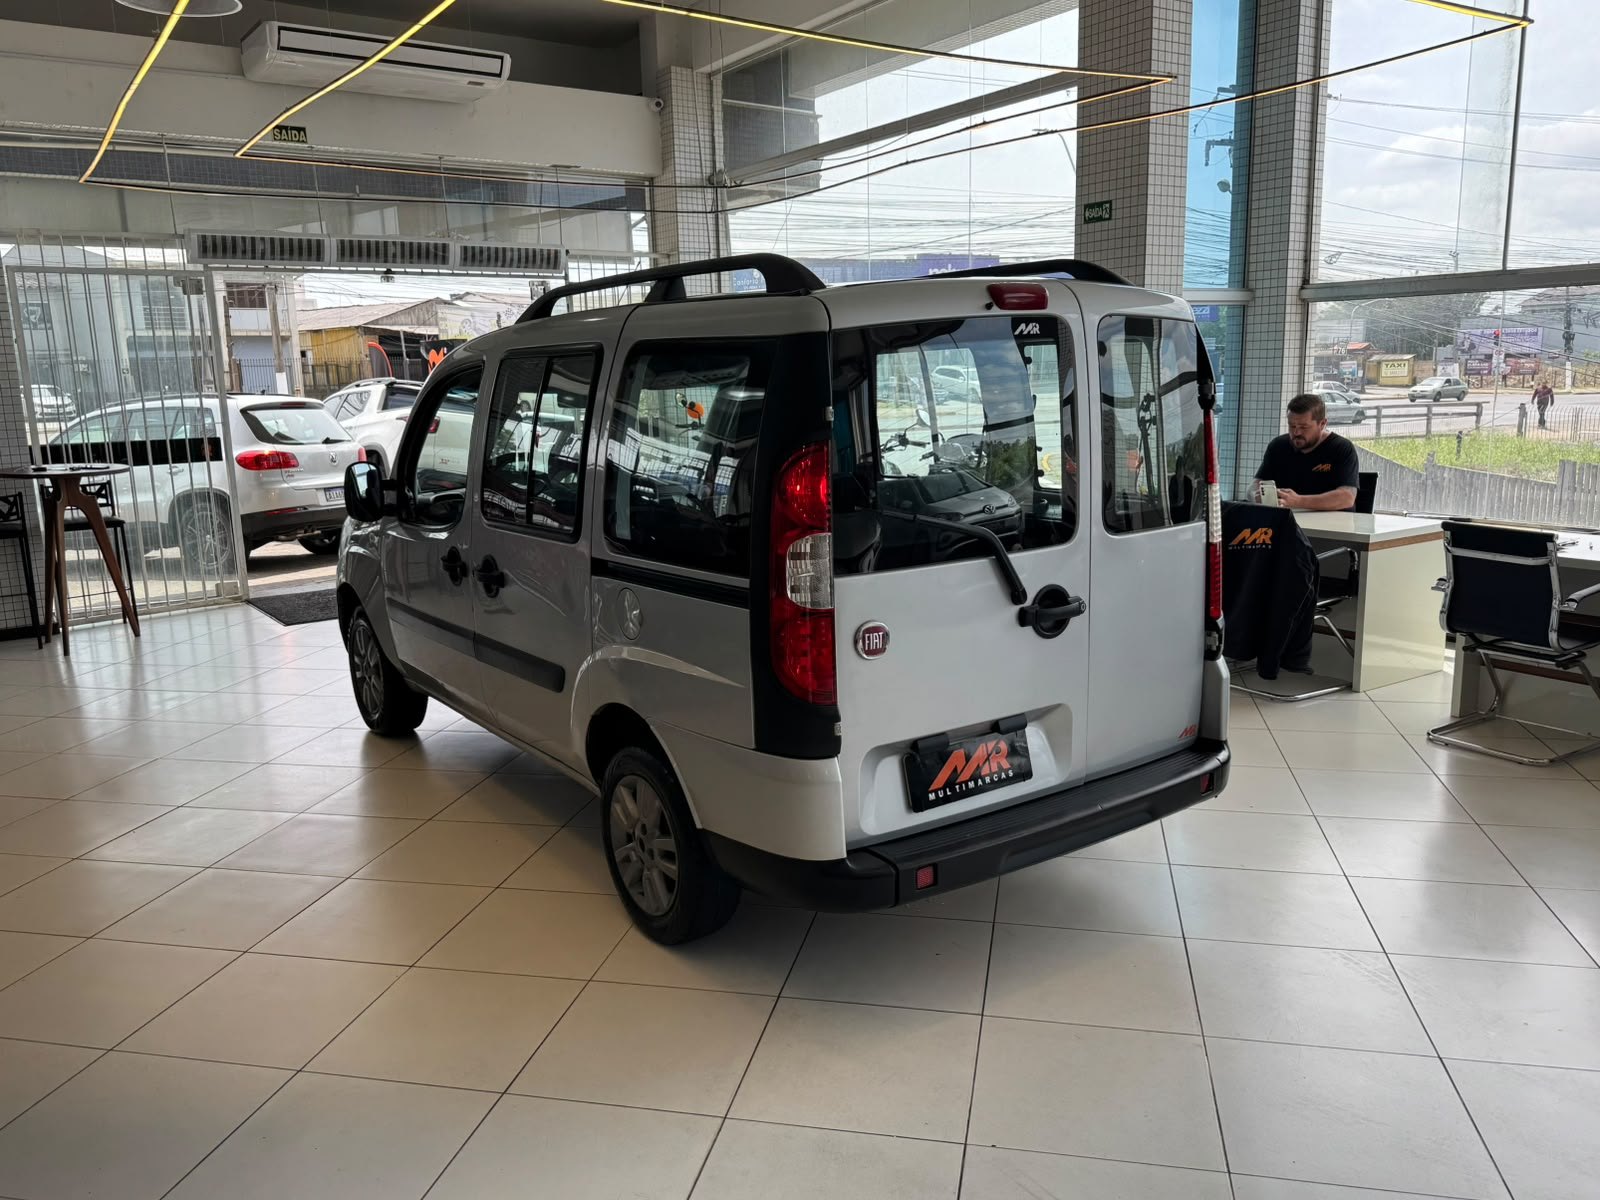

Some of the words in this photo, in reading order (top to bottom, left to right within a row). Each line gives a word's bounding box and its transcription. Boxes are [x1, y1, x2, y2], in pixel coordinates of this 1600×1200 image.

[273, 127, 307, 142] SAÍDA
[864, 631, 884, 651] FIAT
[928, 769, 1014, 801] MULTIMARCAS
